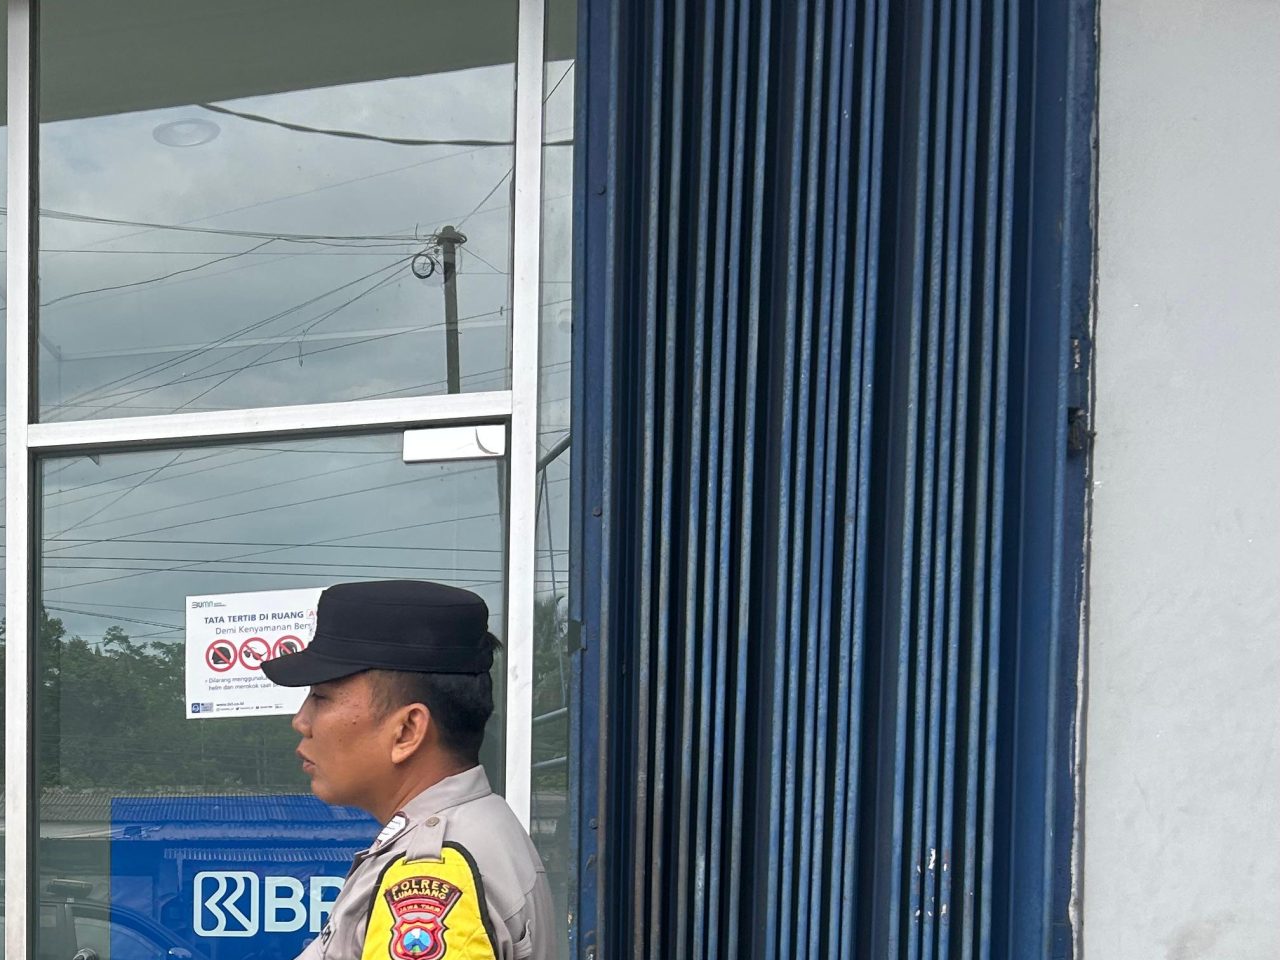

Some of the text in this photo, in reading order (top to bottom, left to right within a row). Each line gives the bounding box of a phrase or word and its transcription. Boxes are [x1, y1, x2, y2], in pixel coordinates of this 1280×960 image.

[204, 616, 225, 624] TATA
[271, 611, 304, 619] RUANG
[216, 627, 236, 635] Demi
[239, 624, 291, 634] Kenyamanan
[391, 879, 450, 893] POLRES
[393, 888, 447, 900] LUMAJANG
[399, 904, 418, 913] JAWA
